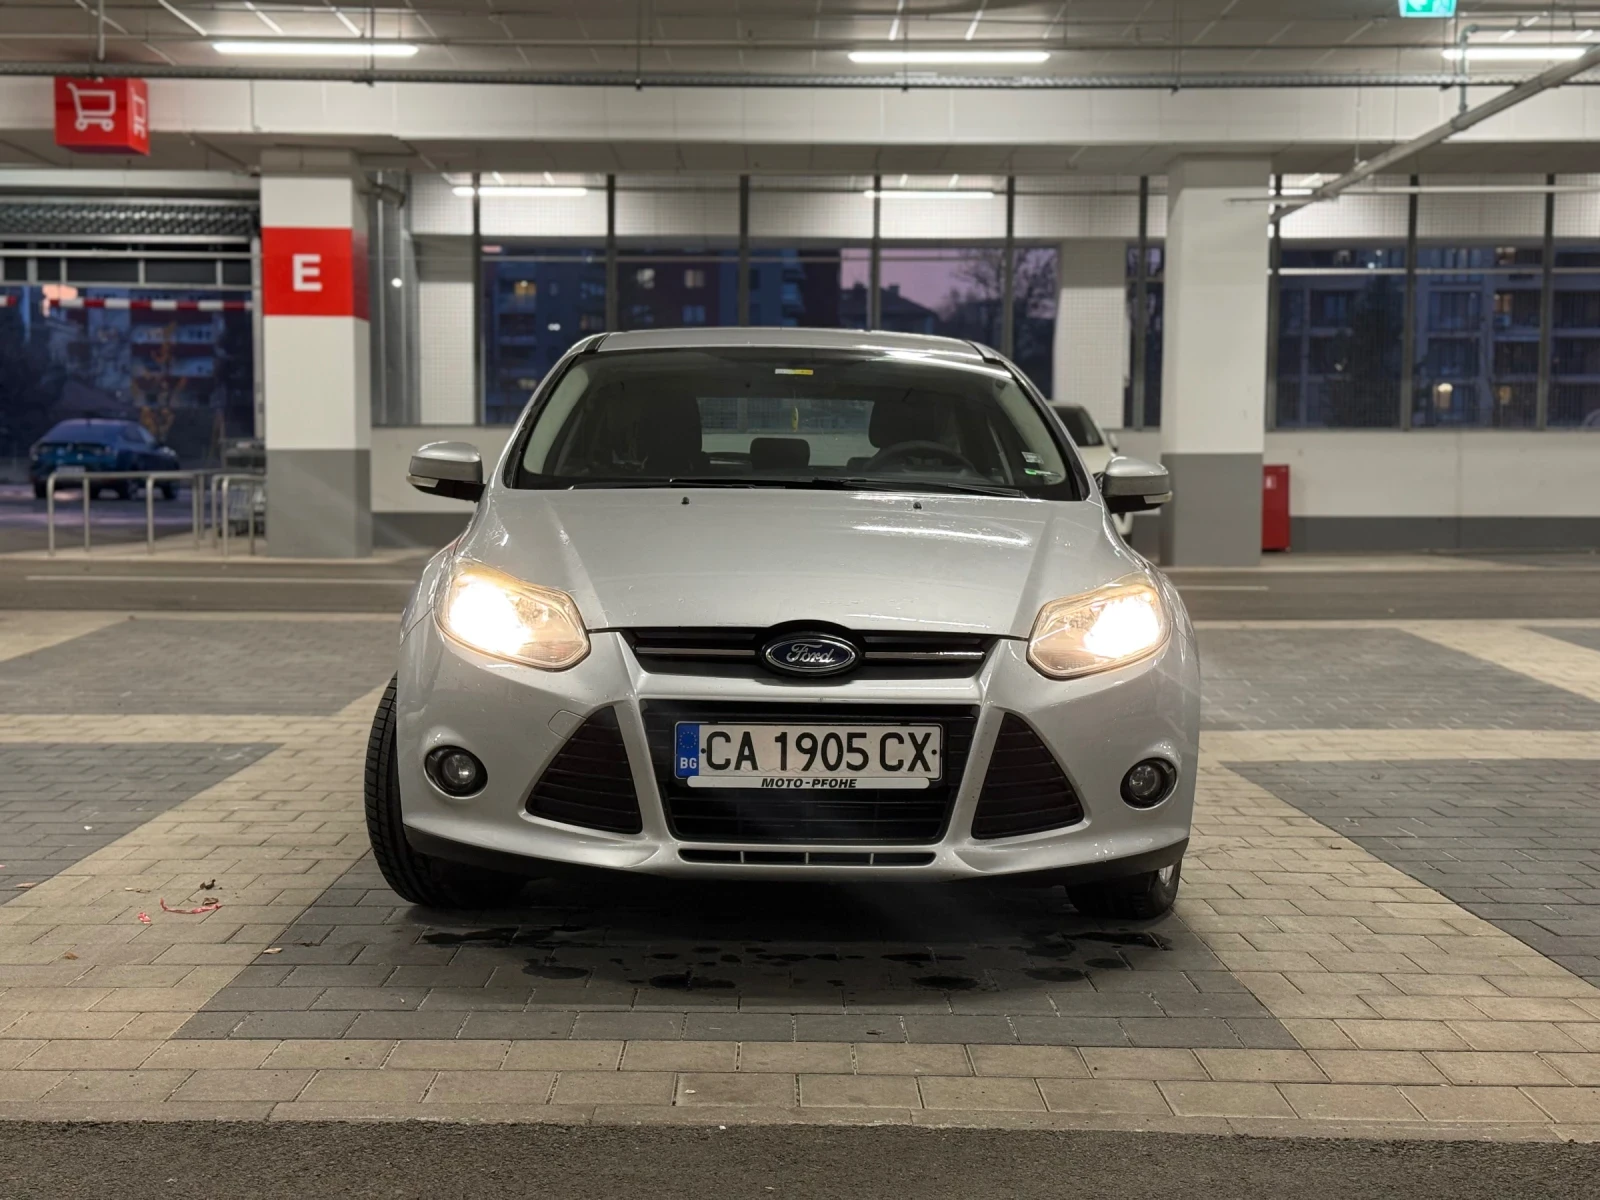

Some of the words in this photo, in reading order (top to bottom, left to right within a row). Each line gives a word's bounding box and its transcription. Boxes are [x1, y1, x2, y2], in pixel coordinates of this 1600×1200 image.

[292, 253, 323, 292] E
[786, 643, 835, 663] Ford
[706, 731, 759, 770] CA
[775, 731, 869, 772] 1905
[879, 732, 932, 772] CX
[680, 757, 697, 769] BG
[761, 778, 857, 788] MOTO-PFOHE
